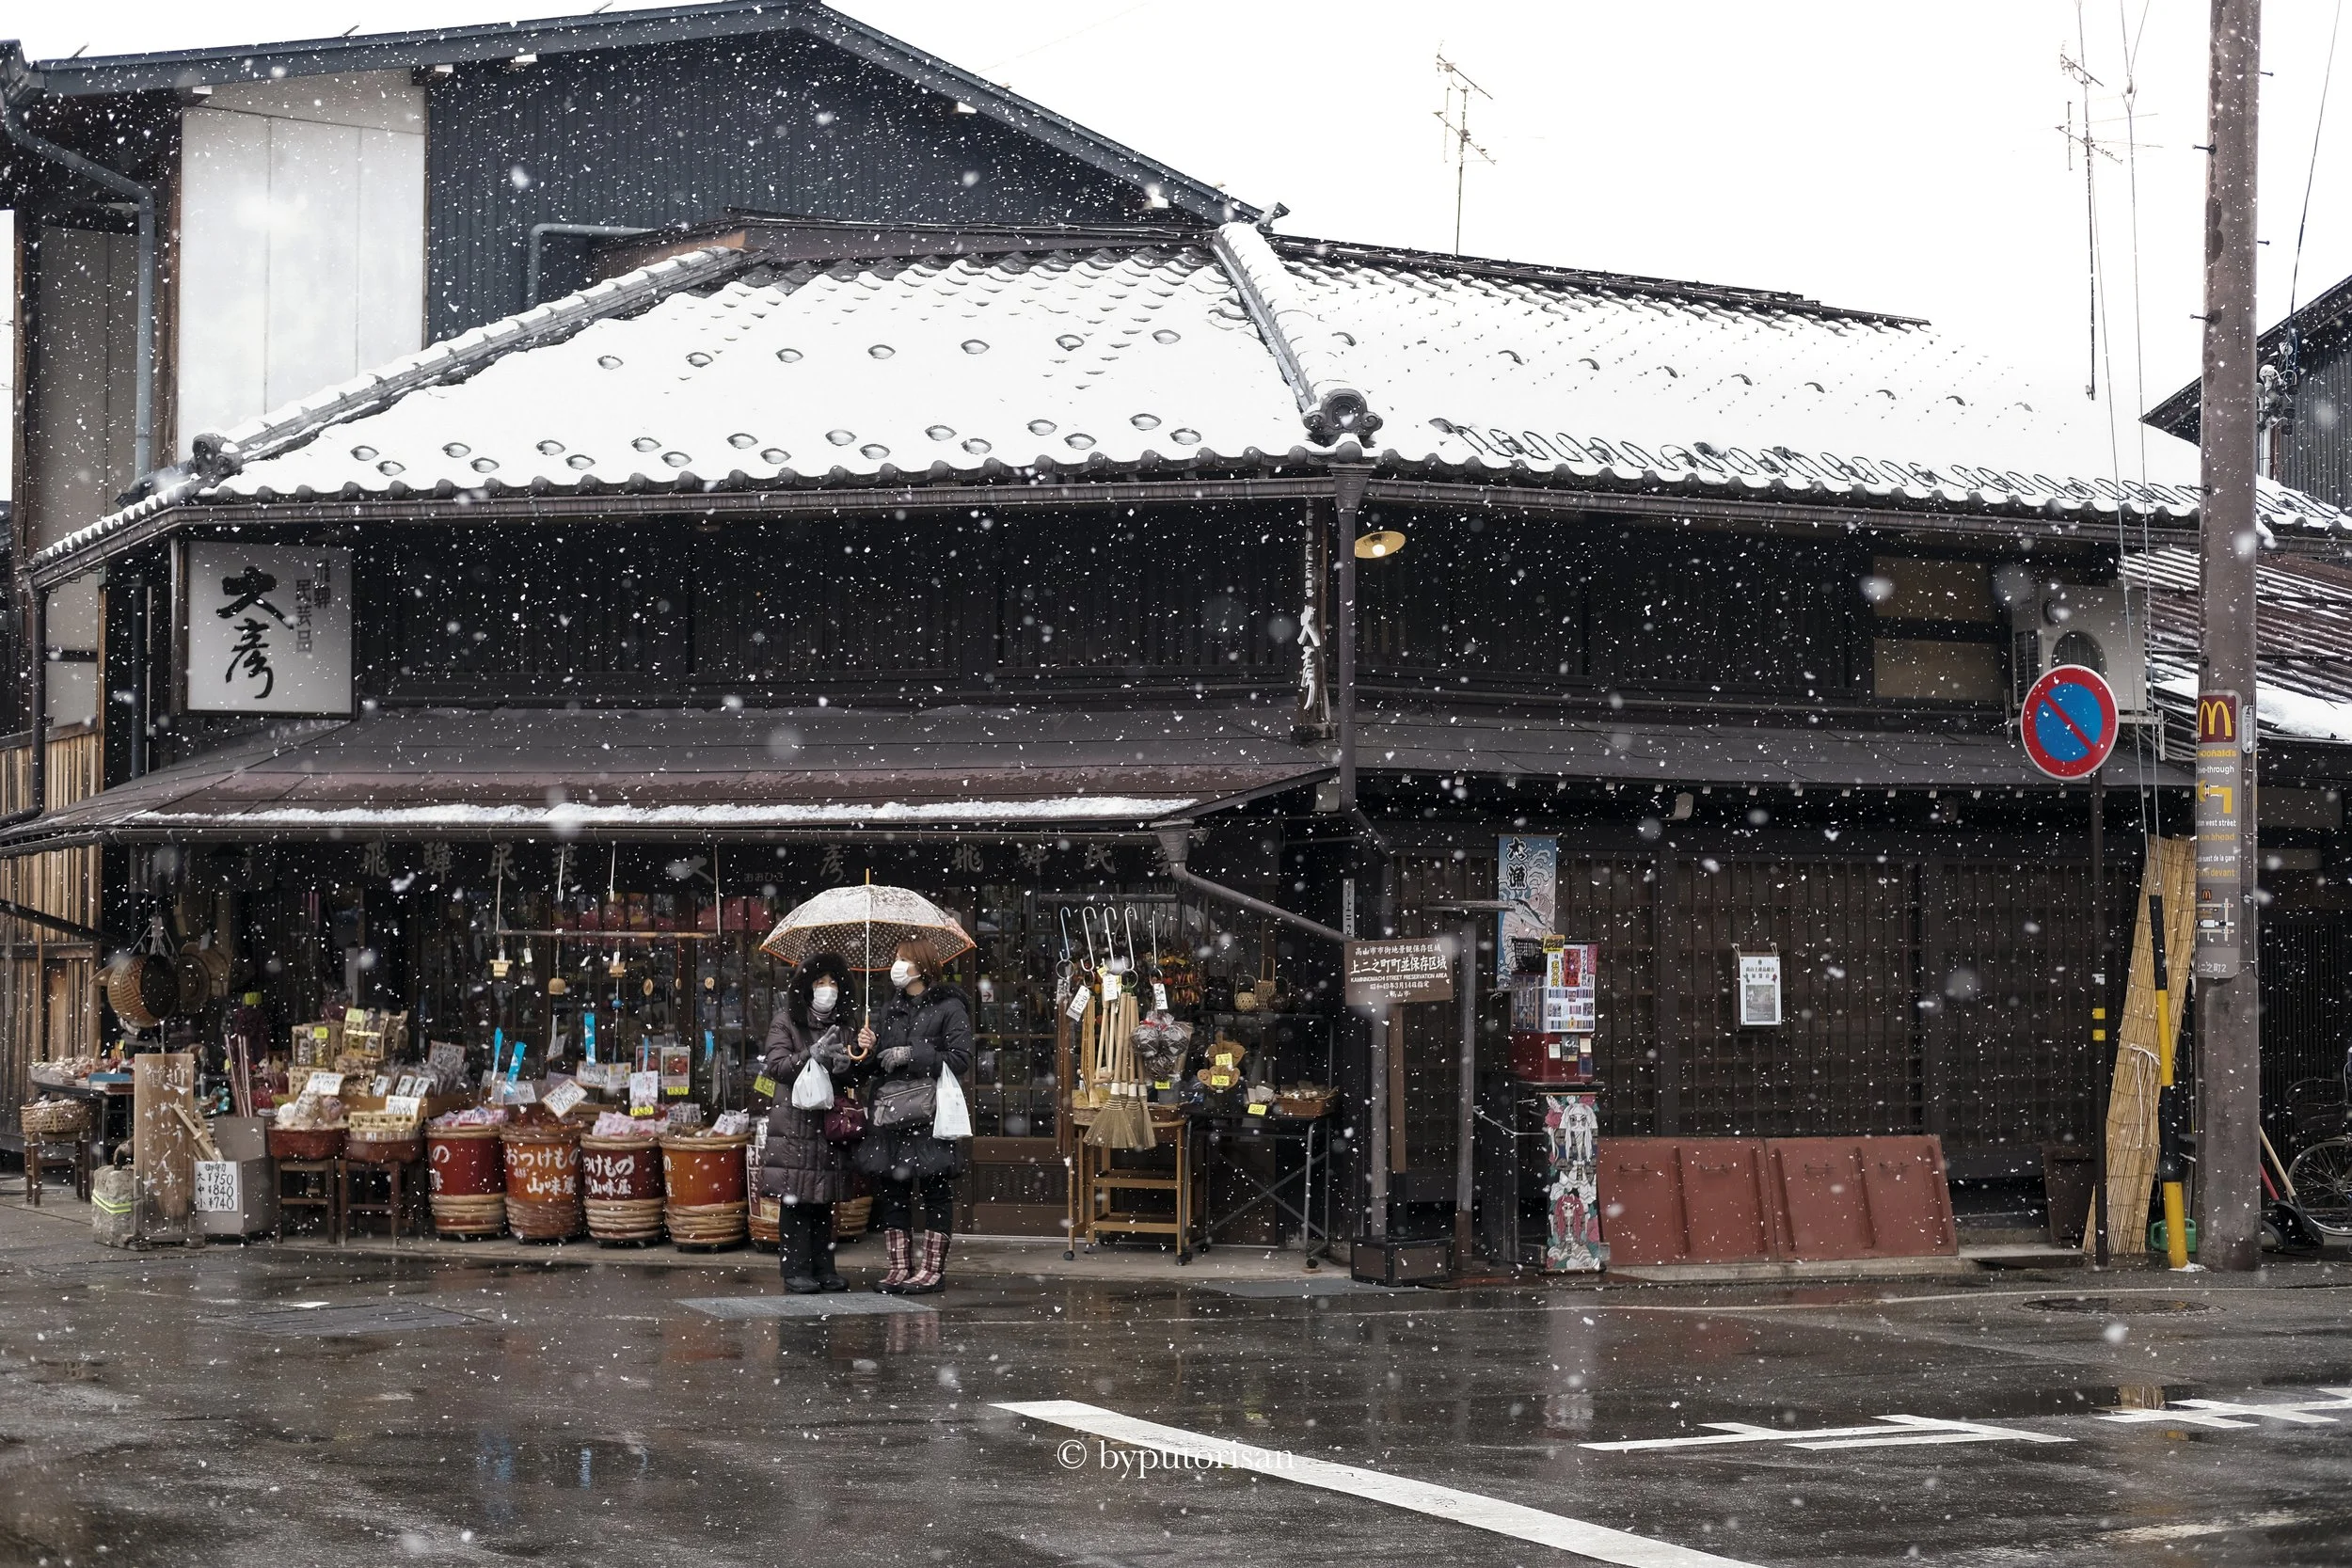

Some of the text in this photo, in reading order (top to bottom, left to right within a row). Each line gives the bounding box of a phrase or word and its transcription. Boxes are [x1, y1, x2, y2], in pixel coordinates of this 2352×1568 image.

[295, 578, 313, 653] 民芸品
[215, 565, 294, 699] 大彦
[2211, 832, 2235, 841] ahead
[1507, 837, 1528, 889] 大漁
[743, 872, 785, 882] おおひこ
[1350, 956, 1448, 974] 上二之町町並保存区域
[433, 1145, 450, 1164] の
[505, 1145, 580, 1169] おつけもの
[208, 1172, 234, 1186] ¥950
[526, 1175, 576, 1196] 山味屋
[591, 1179, 632, 1196] 山味屋
[208, 1185, 234, 1198] ¥840
[209, 1196, 234, 1211] ¥740
